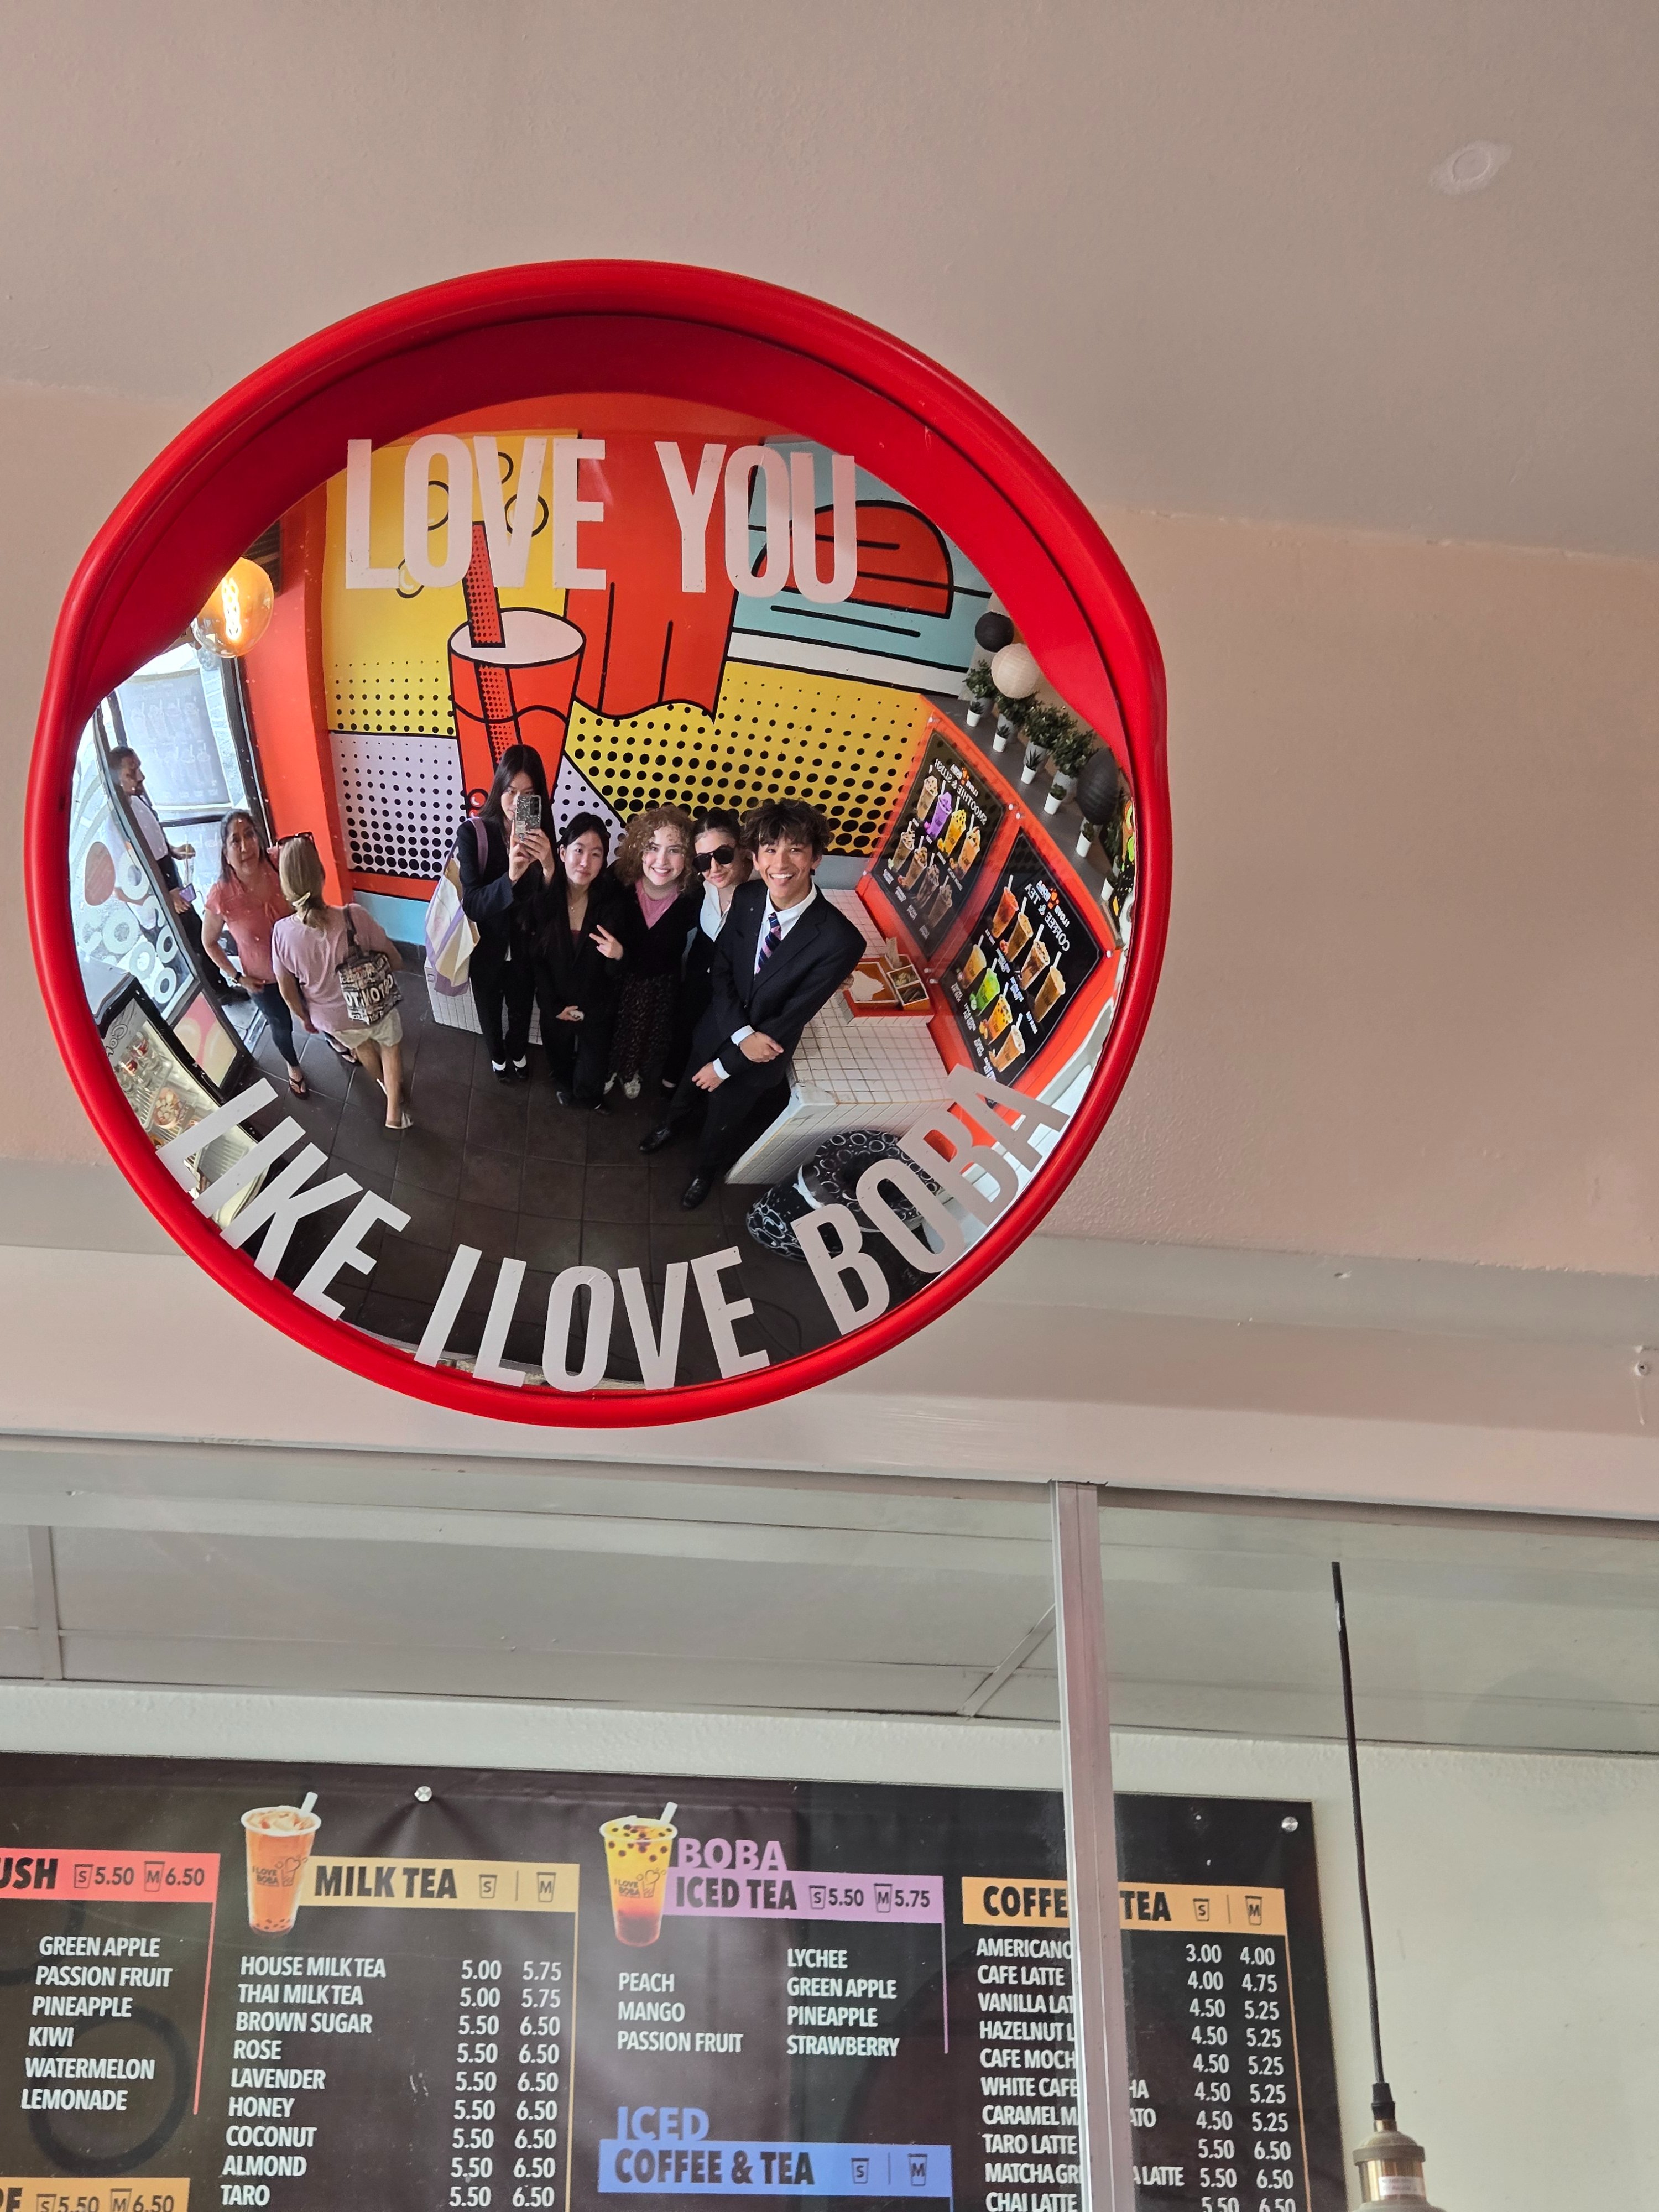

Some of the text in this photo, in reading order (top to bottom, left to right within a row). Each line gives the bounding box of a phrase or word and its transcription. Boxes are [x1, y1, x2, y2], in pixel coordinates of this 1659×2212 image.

[346, 434, 857, 604] LOVE YOU
[155, 1063, 1073, 1392] LIKE I LOVE BOBA
[677, 1838, 787, 1870] BOBA
[95, 1867, 134, 1886] 5.50
[168, 1868, 205, 1886] 6.50
[315, 1865, 395, 1898] MILK
[403, 1867, 457, 1899] TEA
[676, 1876, 740, 1909] ICED
[747, 1879, 797, 1910] TEA
[829, 1888, 864, 1907] 5.50
[894, 1890, 930, 1907] 5.75
[983, 1885, 1067, 1918] COFFE
[1119, 1891, 1172, 1921] TEA
[39, 1936, 161, 1957] GREEN APPLE
[787, 1948, 848, 1969] LYCHEE
[1186, 1944, 1222, 1964] 3.00
[1240, 1946, 1275, 1966] 4.00
[35, 1966, 173, 1987] PASSION FRUIT
[241, 1956, 562, 1981] HOUSE MILK TEA 5.00 5.75
[977, 1965, 1277, 1992] CAFE LATTE 4.00 4.75
[618, 1973, 675, 1993] PEACH
[787, 1977, 897, 1999] GREEN APPLE
[32, 1996, 133, 2017] PINEAPPLE
[238, 1984, 561, 2008] THAI MILK TEA 5.00 5.75
[978, 1992, 1280, 2020] VANILLA LAT 4.50 5.25
[236, 2011, 560, 2036] BROWN SUGAR 5.50 6.50
[618, 2002, 685, 2023] MANGO
[787, 2006, 878, 2028] PINEAPPLE
[28, 2026, 74, 2047] KIWI
[617, 2031, 744, 2053] PASSION FRUIT
[786, 2036, 900, 2057] STRAWBERRY
[979, 2021, 1065, 2041] HAZELNUT
[1191, 2026, 1228, 2046] 4.50
[1246, 2028, 1282, 2048] 5.25
[233, 2039, 559, 2064] ROSE 5.50 6.50
[979, 2048, 1284, 2075] CAFE MOCH 4.50 5.25
[25, 2057, 155, 2079] WATERMELON
[231, 2068, 559, 2092] LAVENDER 5.50 6.50
[21, 2089, 128, 2111] LEMONADE
[980, 2077, 1286, 2104] WHITE CAFE 4.50 5.25
[228, 2096, 557, 2120] HONEY 5.50 6.50
[982, 2105, 1060, 2125] CARAMEL
[1196, 2110, 1233, 2130] 4.50
[1251, 2112, 1288, 2132] 5.25
[617, 2106, 710, 2140] ICED
[226, 2125, 556, 2149] COCONUT 5.50 6.50
[982, 2133, 1291, 2161] TARO LATTE 5.50 6.50
[222, 2155, 556, 2178] ALMOND 5.50 6.50
[615, 2148, 722, 2184] COFFEE
[731, 2151, 752, 2184] &
[760, 2151, 815, 2185] TEA
[984, 2163, 1054, 2183] MATCHA
[1142, 2166, 1185, 2186] LATTE
[1199, 2168, 1237, 2188] 5.50
[1256, 2169, 1293, 2189] 6.50
[59, 2196, 100, 2212] 5.50
[133, 2195, 174, 2212] 6.50
[221, 2184, 554, 2207] TARO 5.50 6.50
[985, 2192, 1296, 2212] CHAI LATTE 550 650
